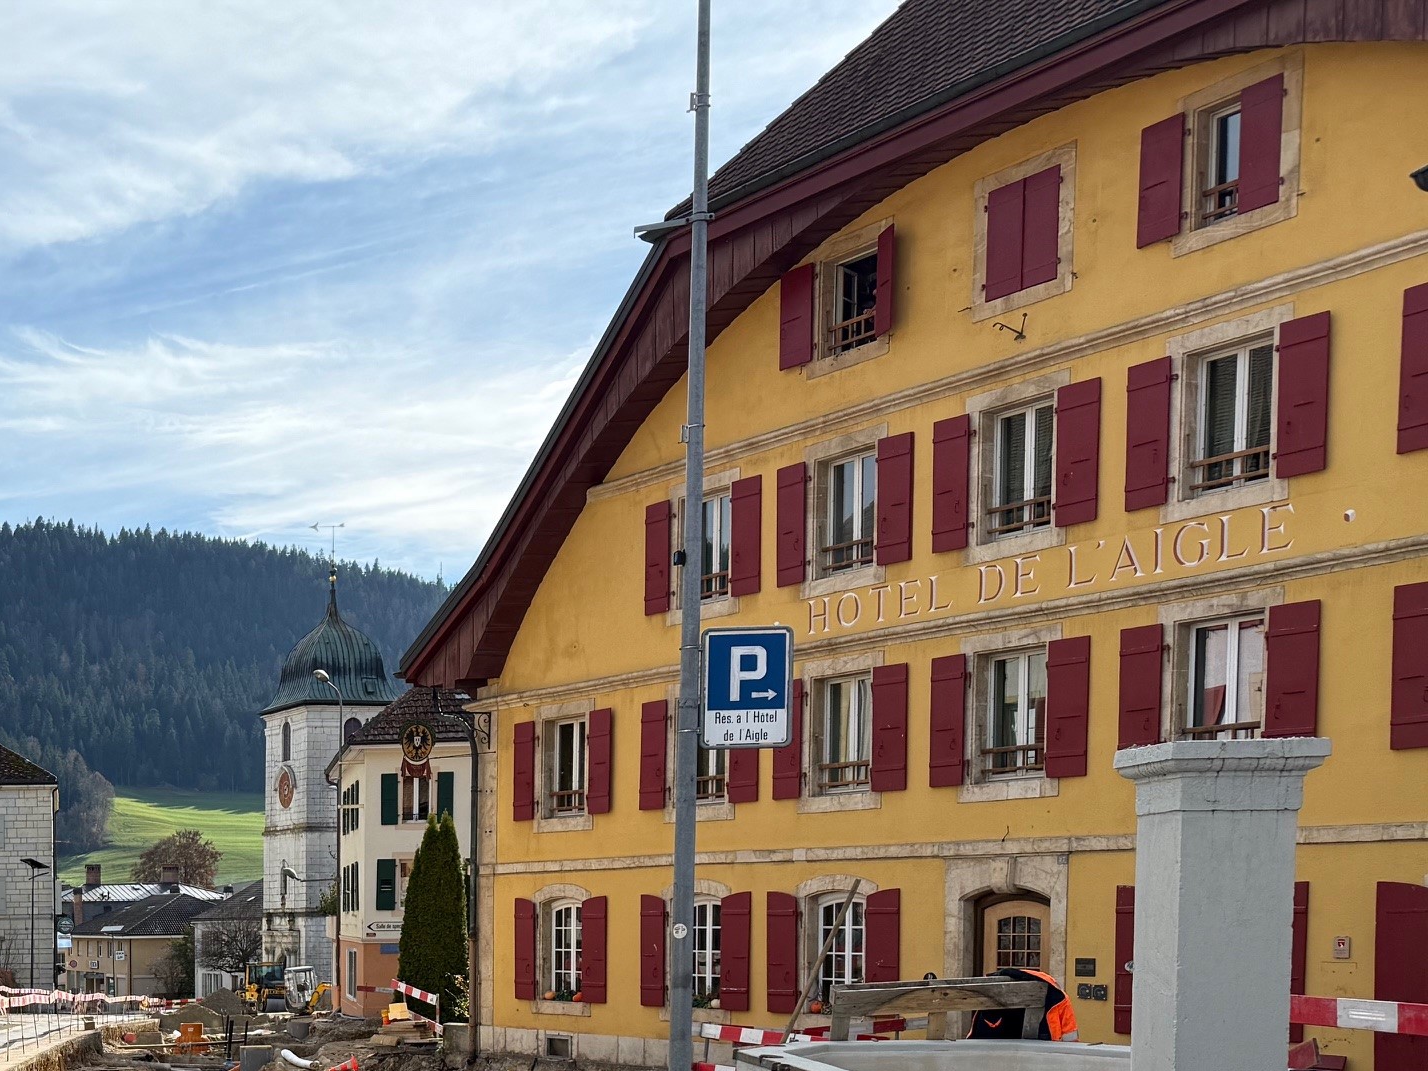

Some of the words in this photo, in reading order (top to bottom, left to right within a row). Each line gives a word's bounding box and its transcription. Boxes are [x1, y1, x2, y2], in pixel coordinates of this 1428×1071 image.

[808, 576, 953, 635] HOTEL
[977, 555, 1041, 604] DE
[1066, 503, 1295, 588] L'AIGLE
[729, 645, 768, 702] P
[723, 729, 734, 741] de
